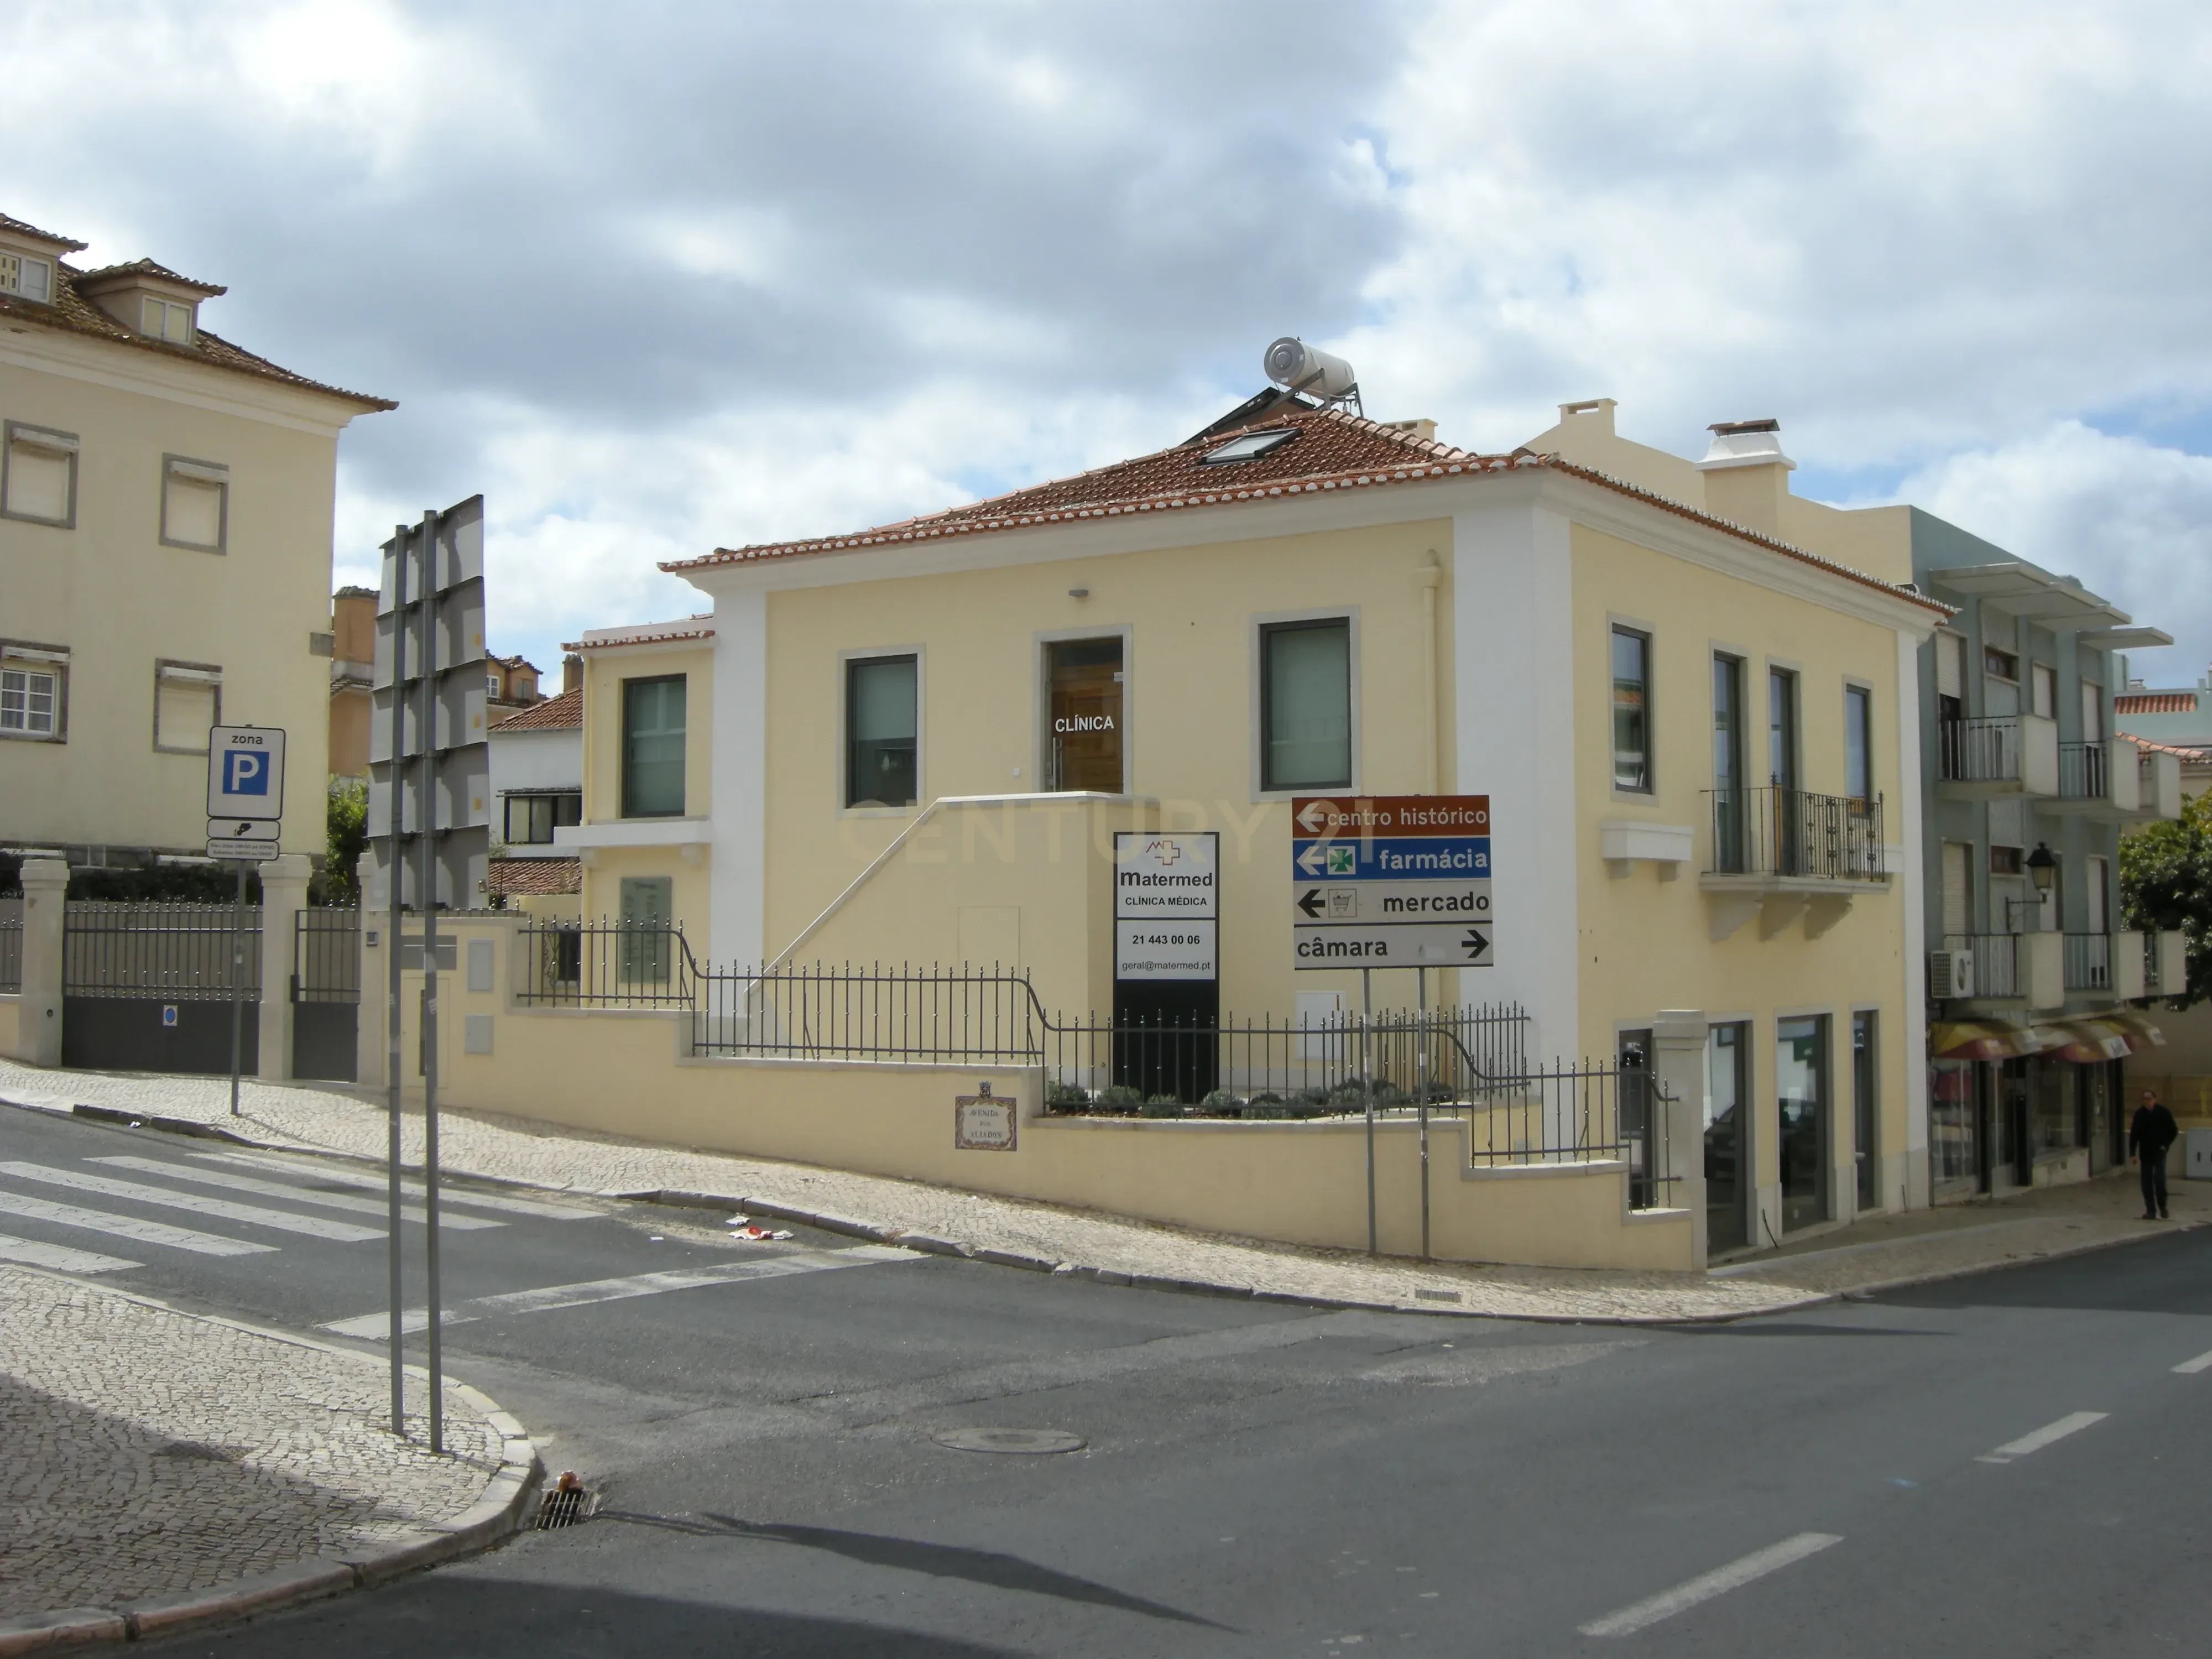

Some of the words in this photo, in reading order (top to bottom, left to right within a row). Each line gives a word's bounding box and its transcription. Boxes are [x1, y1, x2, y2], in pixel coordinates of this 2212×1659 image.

[1055, 714, 1114, 733] CLÍNICA
[232, 734, 263, 745] zona
[232, 754, 259, 791] P
[1327, 808, 1392, 826] centro
[1400, 807, 1487, 826] histórico
[1379, 849, 1488, 870] farmácia
[1120, 871, 1213, 887] matermed
[1125, 895, 1165, 905] CLÍNICA
[1168, 895, 1207, 905] MÉDICA
[1383, 891, 1490, 912] mercado
[1133, 935, 1144, 945] 21
[1149, 935, 1167, 945] 443
[1171, 935, 1184, 945] 00
[1187, 935, 1200, 945] 06
[1297, 937, 1388, 958] câmara
[1122, 961, 1211, 971] geral@matermed.pt
[969, 1109, 999, 1117] AVENIDA
